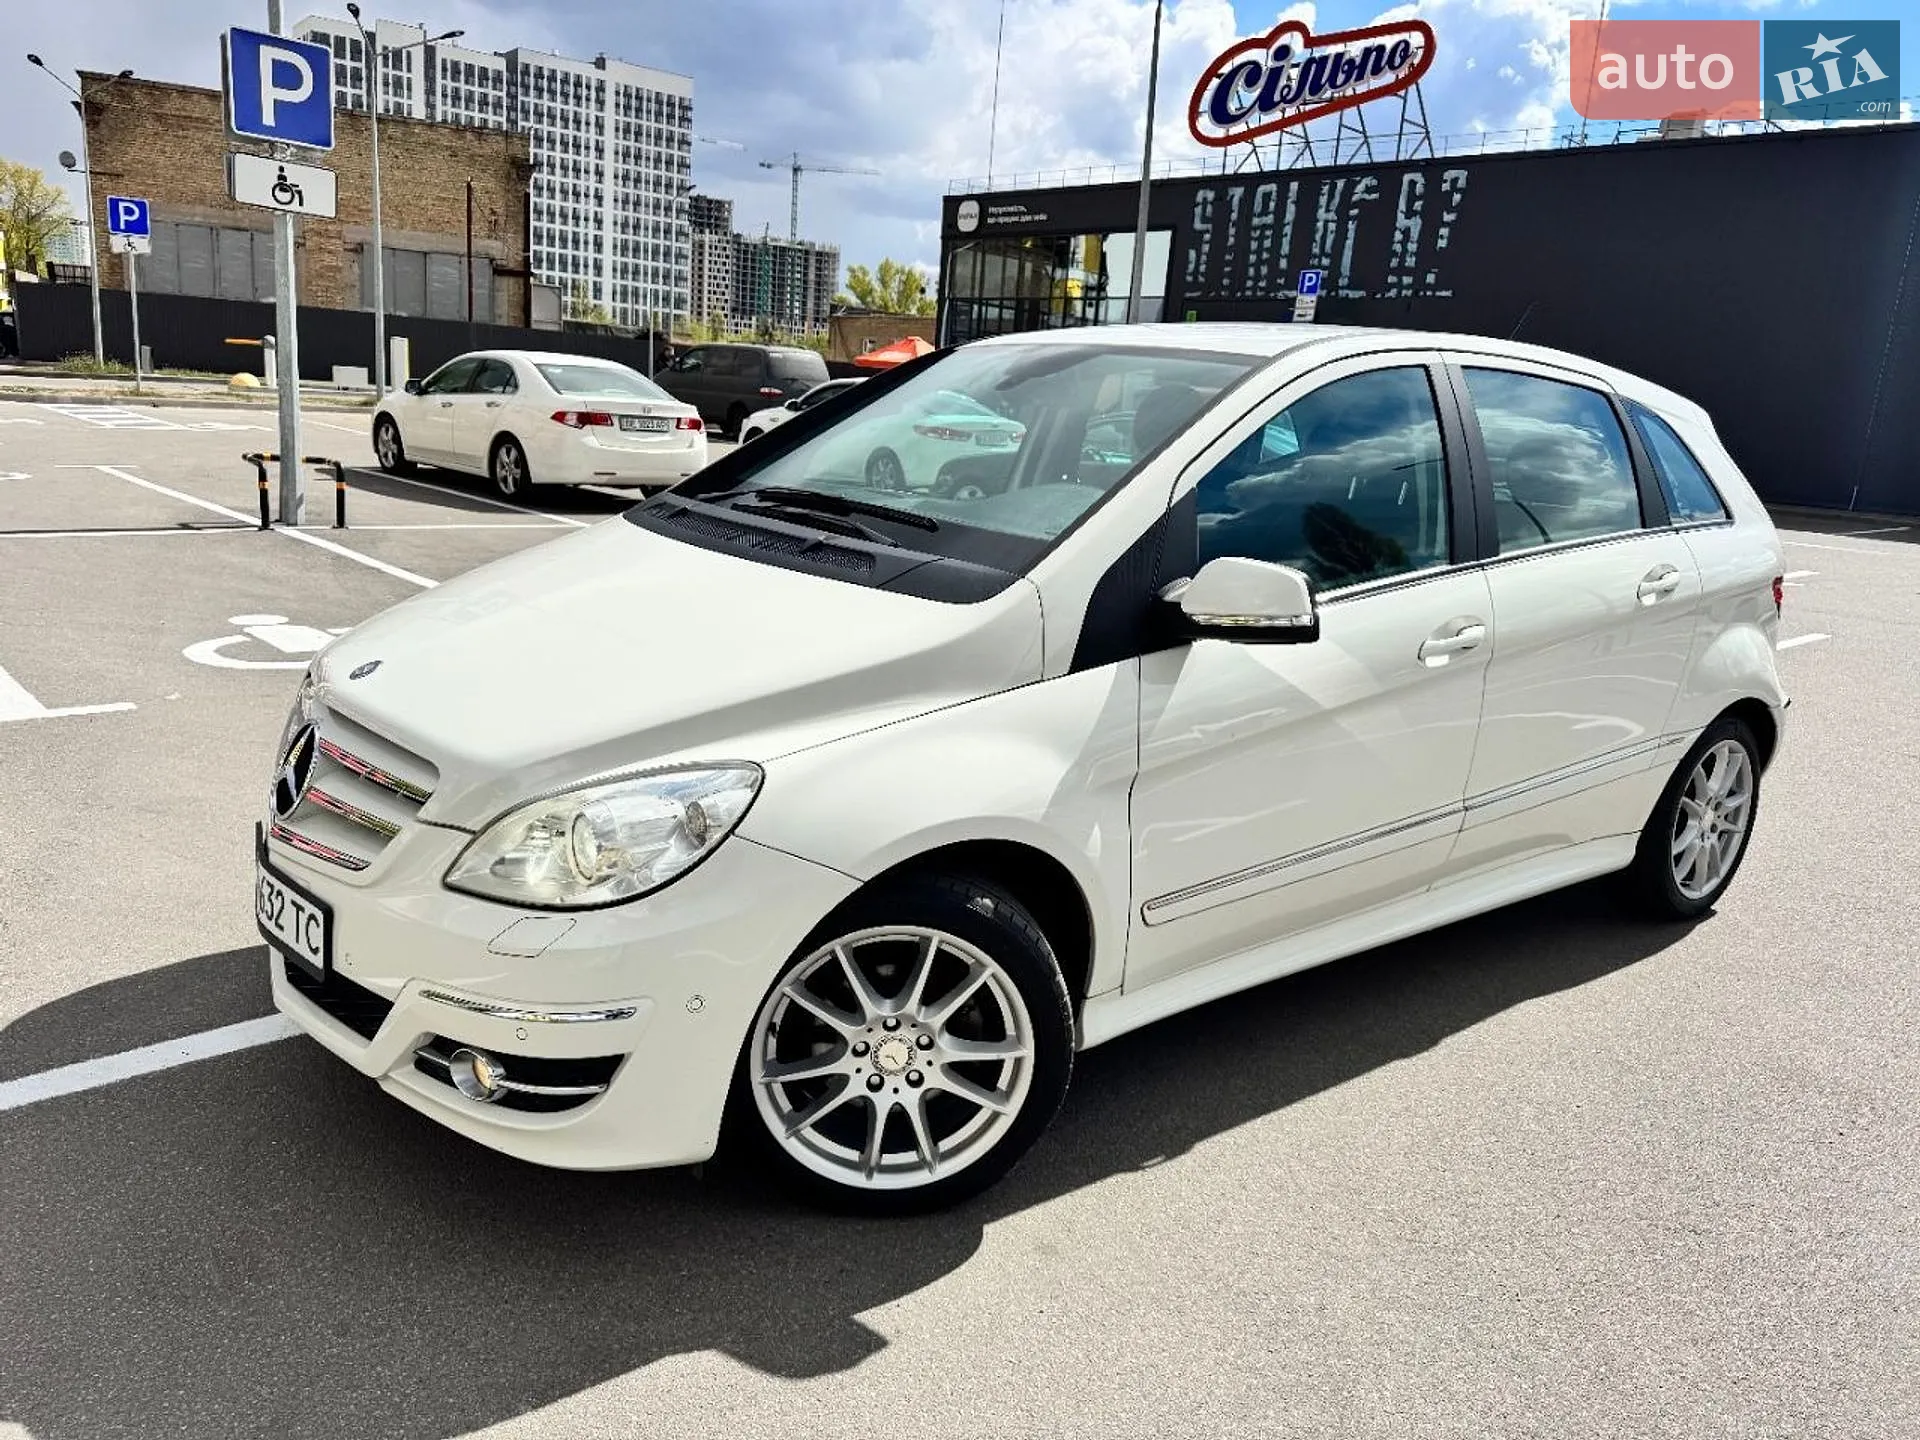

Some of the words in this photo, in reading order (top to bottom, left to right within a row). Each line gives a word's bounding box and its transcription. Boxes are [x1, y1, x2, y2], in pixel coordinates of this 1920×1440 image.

[259, 44, 314, 128] P
[1209, 38, 1413, 126] Сільпо
[118, 201, 140, 230] P
[1303, 273, 1317, 292] P
[290, 898, 321, 957] TC
